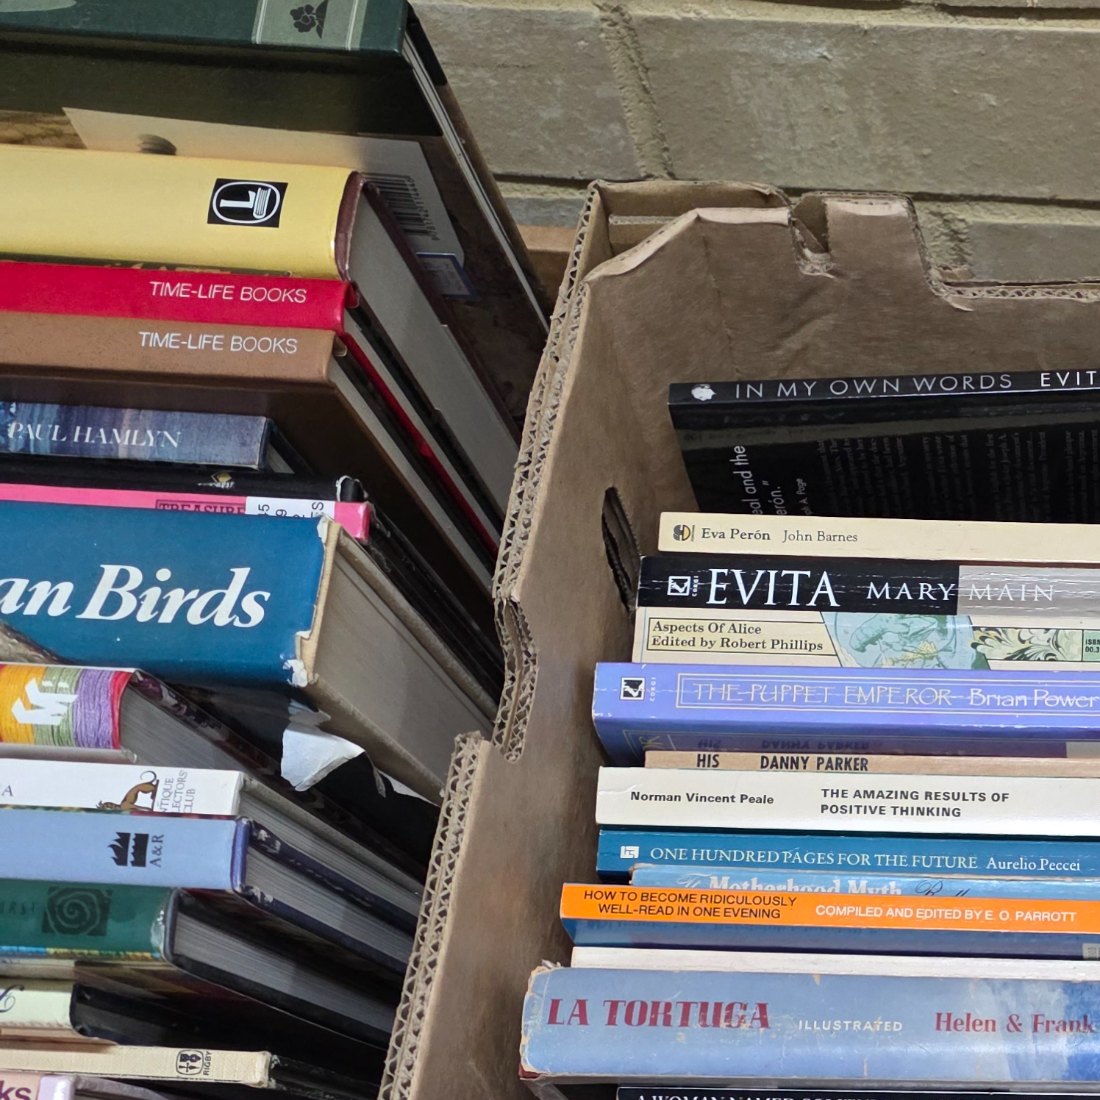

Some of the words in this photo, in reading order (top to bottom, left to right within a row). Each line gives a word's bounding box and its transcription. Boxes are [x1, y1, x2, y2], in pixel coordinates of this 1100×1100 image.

[150, 281, 235, 302] TIME-LIFE
[240, 285, 307, 305] BOOKS
[138, 331, 224, 352] TIME-LIFE
[230, 335, 298, 355] BOOKS
[735, 383, 763, 399] IN
[777, 381, 817, 397] MY
[829, 377, 899, 396] OWN
[912, 373, 1012, 392] WORDS
[9, 421, 66, 443] PAUL
[73, 425, 181, 448] HAMLYN
[701, 528, 726, 539] Eva
[730, 529, 771, 541] Perón
[782, 530, 812, 543] John
[817, 531, 858, 543] Barnes
[76, 564, 270, 627] Birds
[706, 568, 840, 607] EVITA
[866, 581, 956, 601] MARY
[969, 583, 1054, 602] MAIN
[653, 621, 704, 635] Aspects
[708, 623, 725, 634] Of
[728, 623, 761, 635] Alice
[651, 636, 695, 647] Edited
[700, 636, 715, 649] by
[720, 638, 766, 649] Robert
[770, 639, 823, 651] Phillips
[696, 754, 720, 768] HIS
[760, 755, 808, 770] DANNY
[816, 757, 869, 771] PARKER
[630, 790, 681, 802] Norman
[686, 792, 735, 804] Vincent
[740, 793, 774, 805] Peale
[821, 788, 848, 799] THE
[853, 789, 919, 801] AMAZING
[924, 790, 986, 802] RESULTS
[991, 791, 1009, 803] OF
[820, 804, 886, 816] POSITIVE
[891, 805, 961, 817] THINKING
[650, 848, 688, 861] ONE
[691, 849, 780, 863] HUNDRED
[782, 850, 834, 864] PAGES
[837, 853, 870, 866] FOR
[876, 854, 908, 867] THE
[912, 855, 977, 868] FUTURE
[986, 857, 1036, 870] Aurelio
[1040, 858, 1081, 872] Peccei
[584, 890, 617, 901] HOW
[620, 891, 638, 901] TO
[641, 892, 697, 904] BECOME
[700, 894, 797, 907] RIDICULOUSLY
[598, 904, 674, 916] WELL-READ
[677, 906, 690, 916] IN
[693, 907, 721, 918] ONE
[723, 908, 781, 919] EVENING
[203, 1050, 212, 1076] RIGBY
